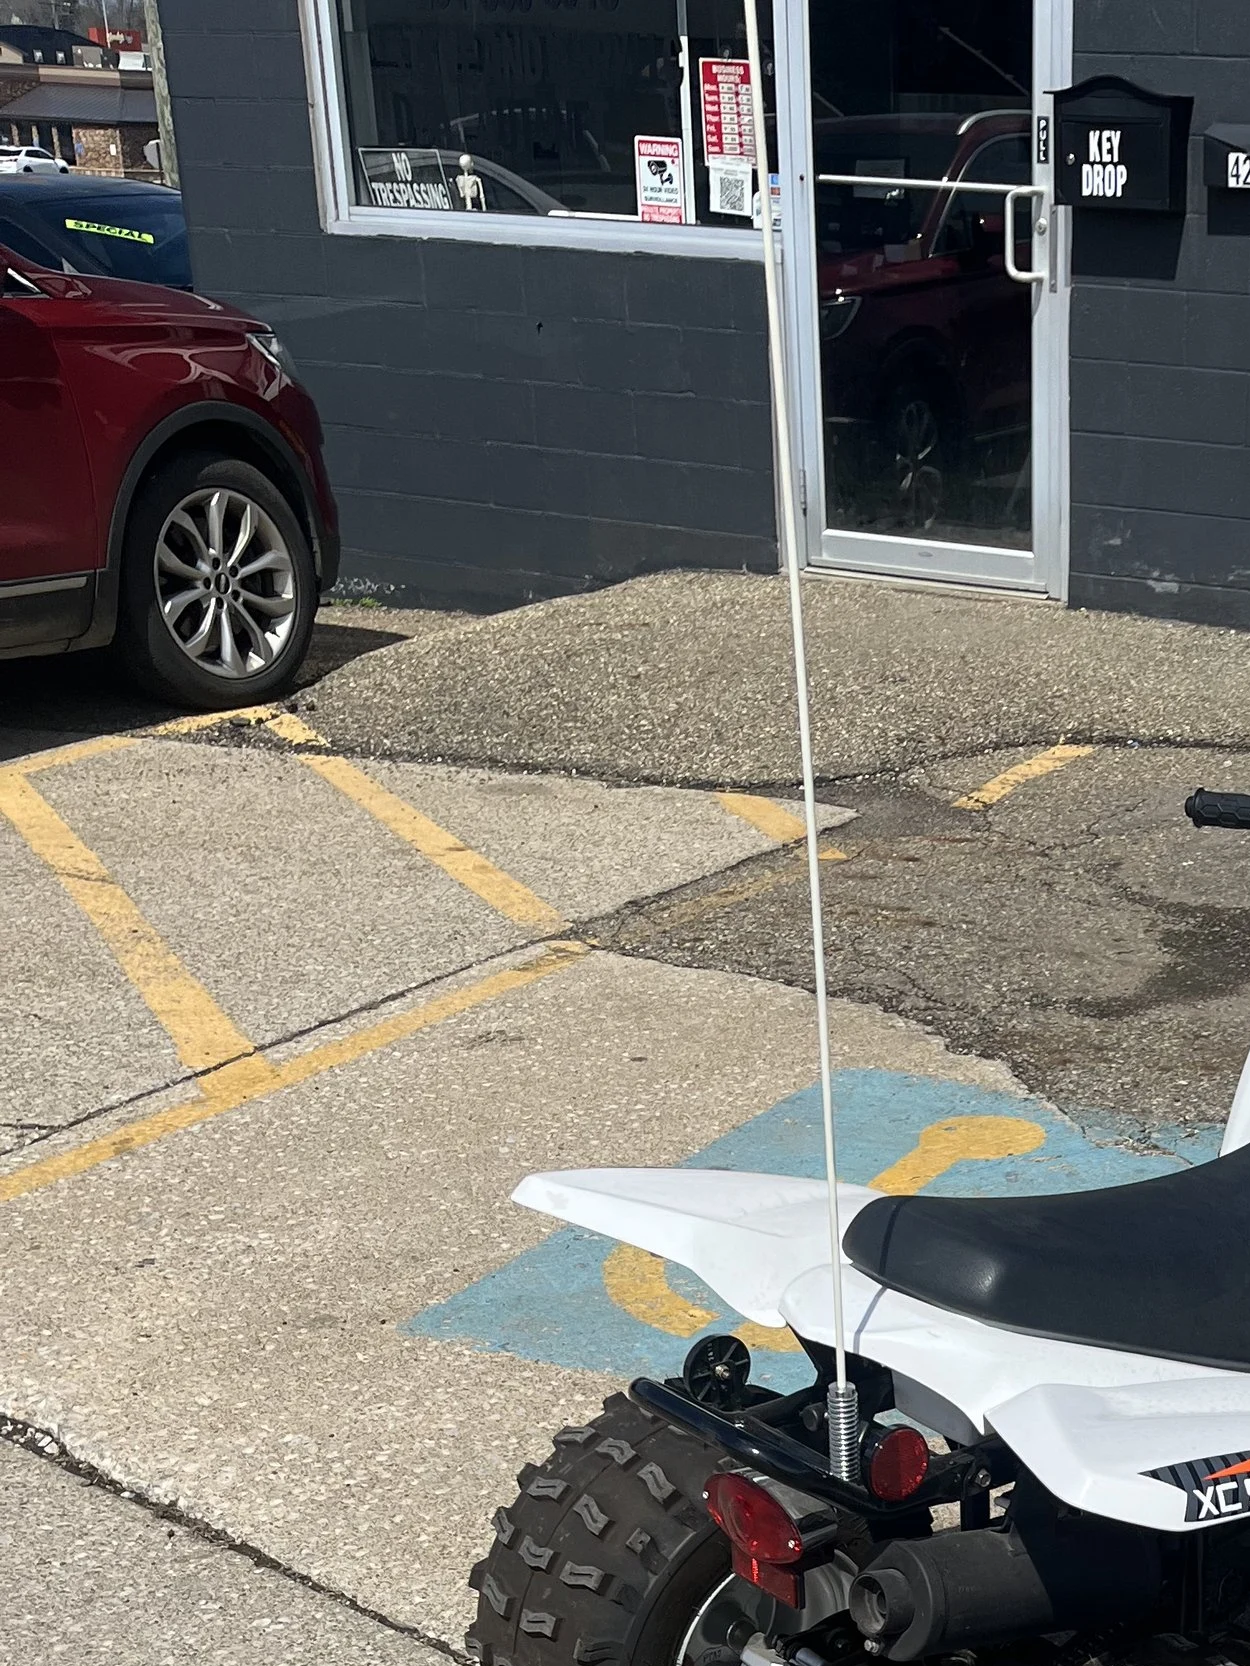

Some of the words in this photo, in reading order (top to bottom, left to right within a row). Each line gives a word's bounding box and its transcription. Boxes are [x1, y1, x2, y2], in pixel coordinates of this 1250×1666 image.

[639, 143, 679, 157] WARNING
[1039, 119, 1047, 162] PULL
[1089, 130, 1121, 163] KEY
[392, 152, 412, 181] NO
[1082, 164, 1127, 197] DROP
[371, 181, 451, 210] TRESPASSING
[73, 221, 148, 242] SPECIAL
[1193, 1481, 1243, 1519] XC
